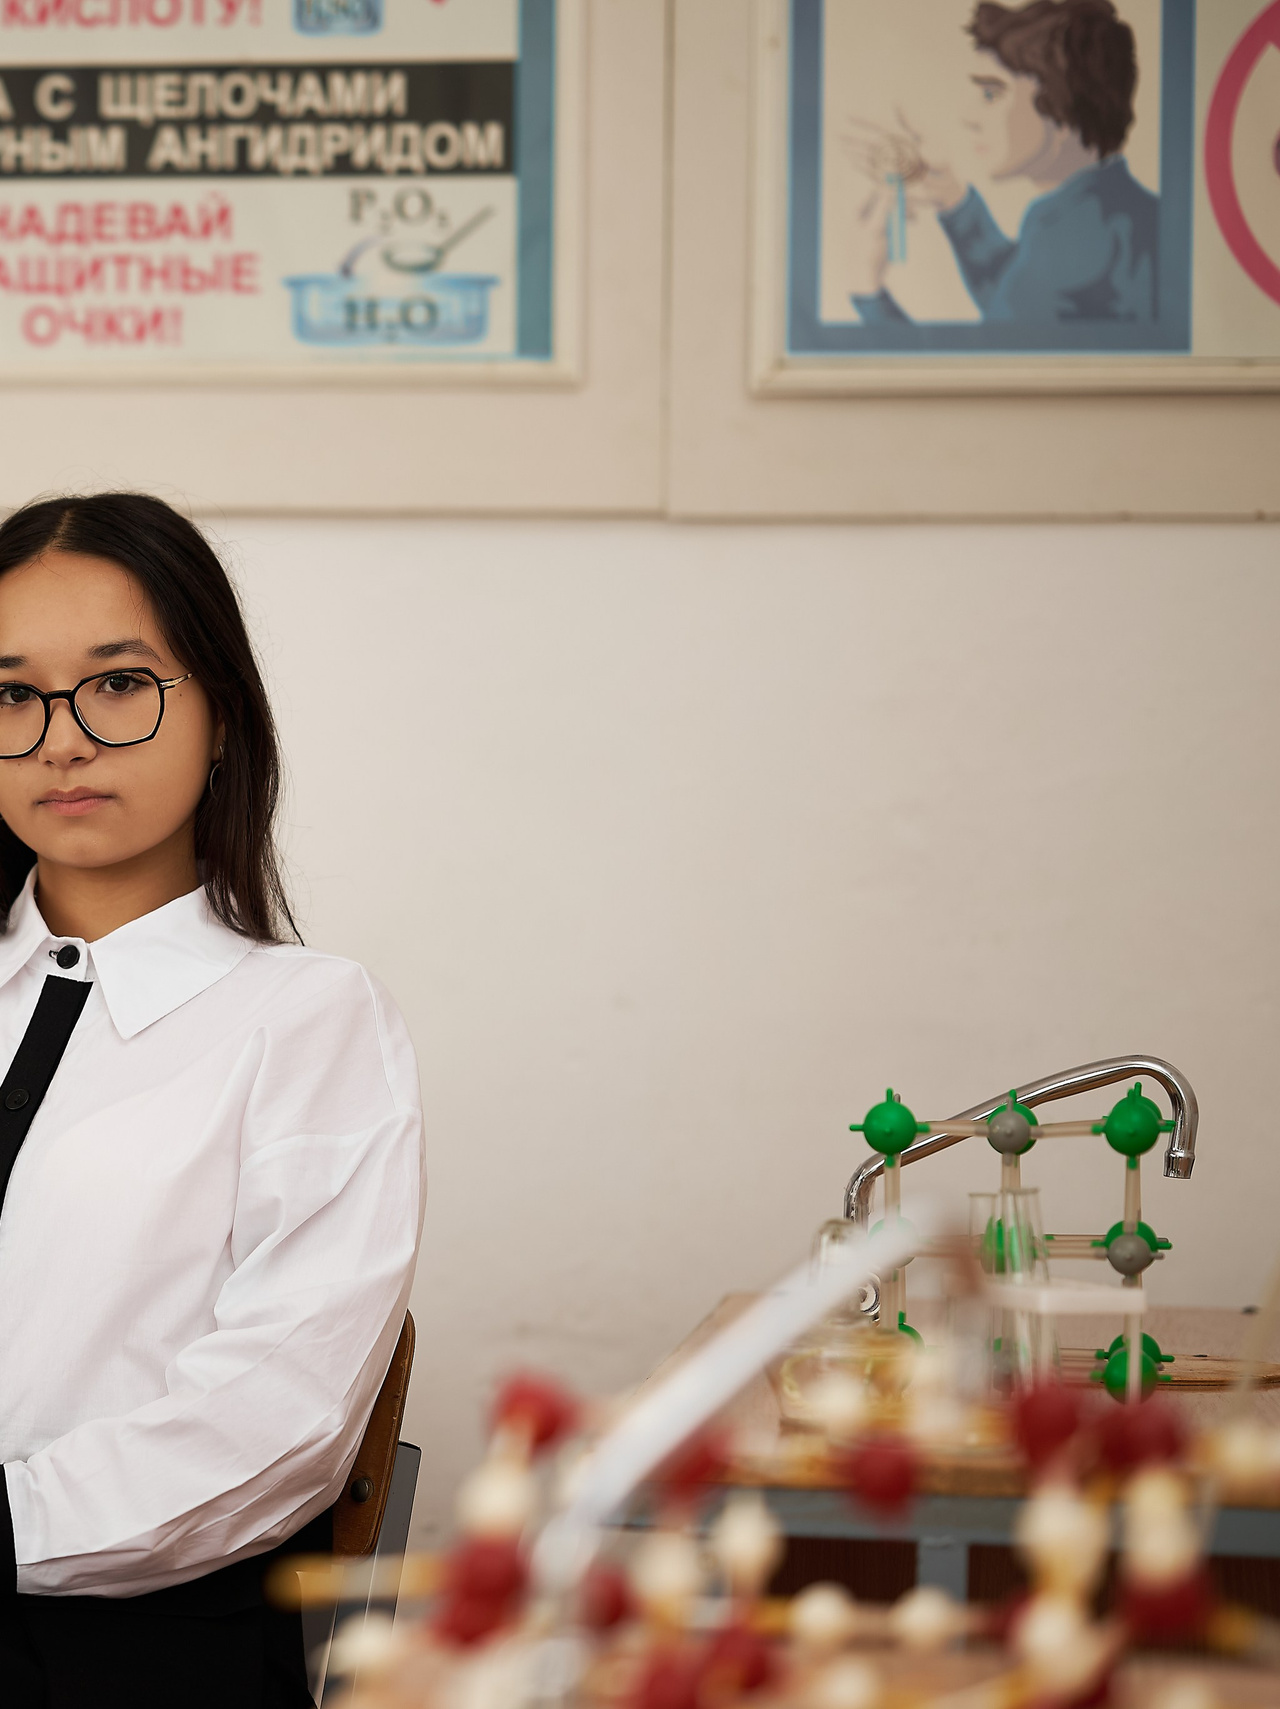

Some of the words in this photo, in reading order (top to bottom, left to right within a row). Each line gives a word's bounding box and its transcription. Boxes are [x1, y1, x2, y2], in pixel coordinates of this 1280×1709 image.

[35, 74, 75, 119] С
[99, 72, 407, 124] ЩЕЛОЧАМИ
[147, 121, 504, 173] АНГИДРИДОМ
[22, 305, 183, 347] ОЧКИ!
